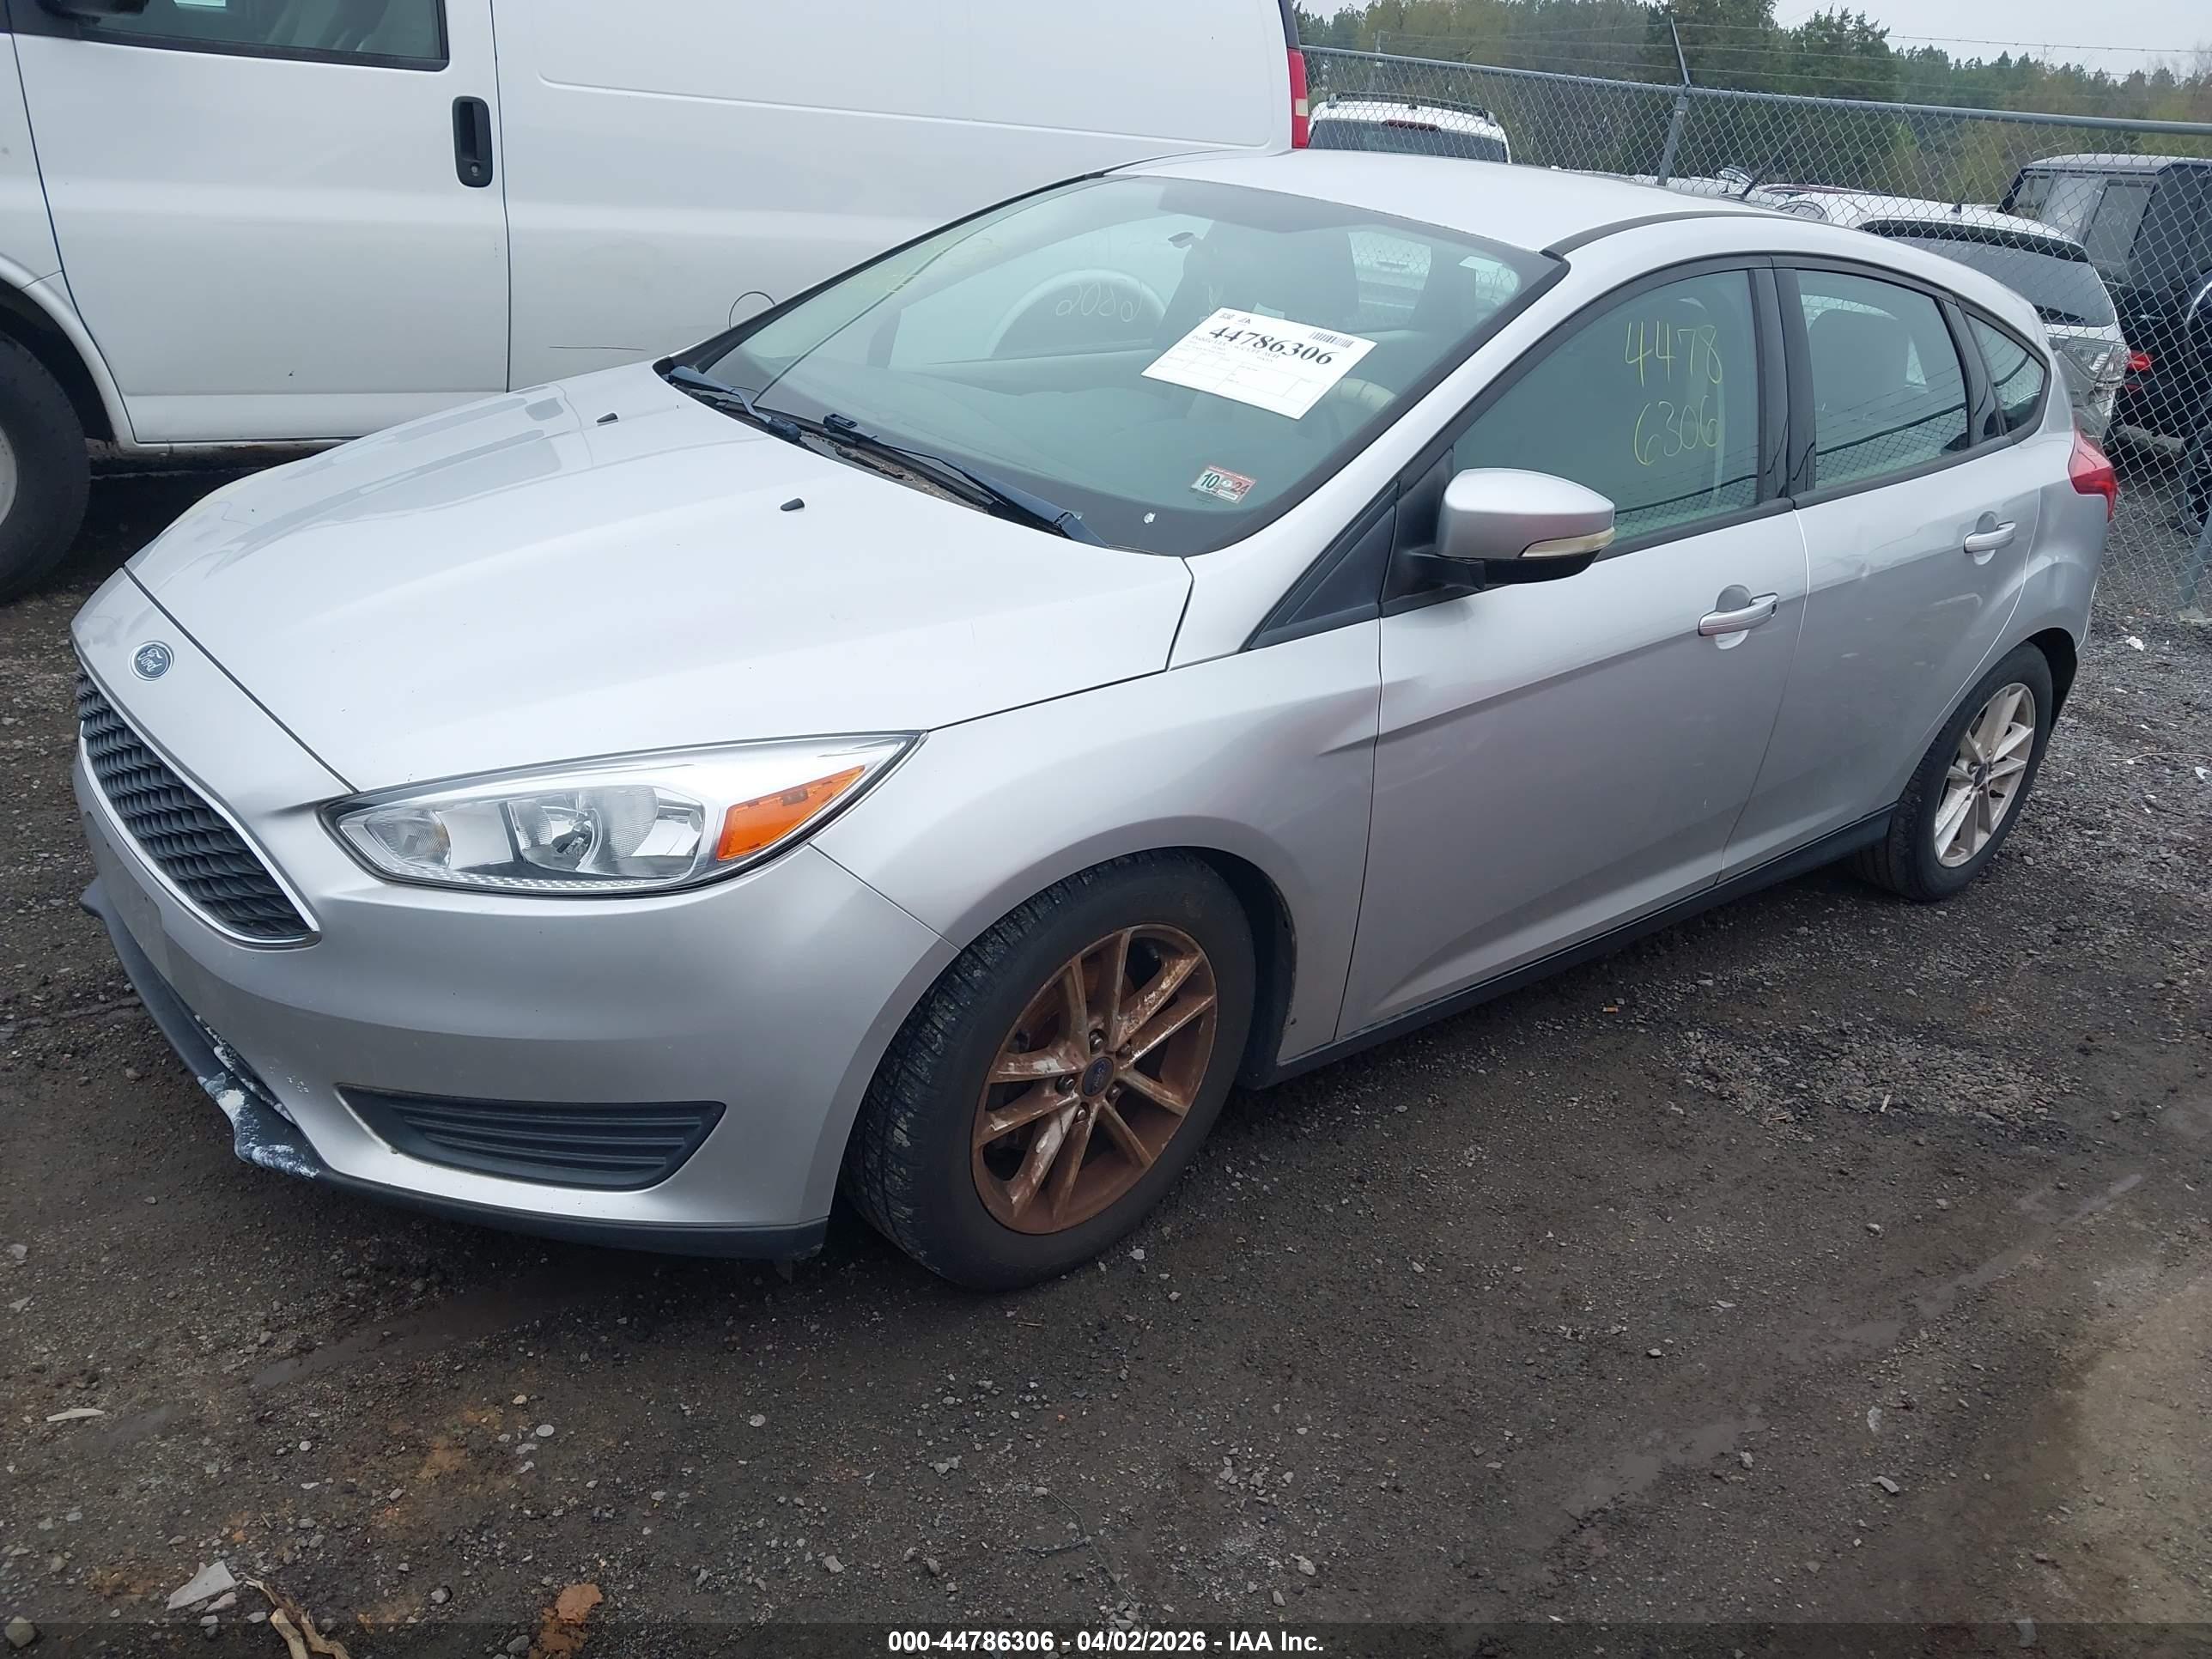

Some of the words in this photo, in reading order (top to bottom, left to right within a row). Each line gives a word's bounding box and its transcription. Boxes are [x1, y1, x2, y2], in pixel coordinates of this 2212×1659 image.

[1209, 326, 1339, 365] 44786306
[1625, 320, 1723, 387] 4478
[1634, 394, 1720, 465] 6306
[1200, 472, 1220, 489] 10
[137, 648, 163, 672] Ford
